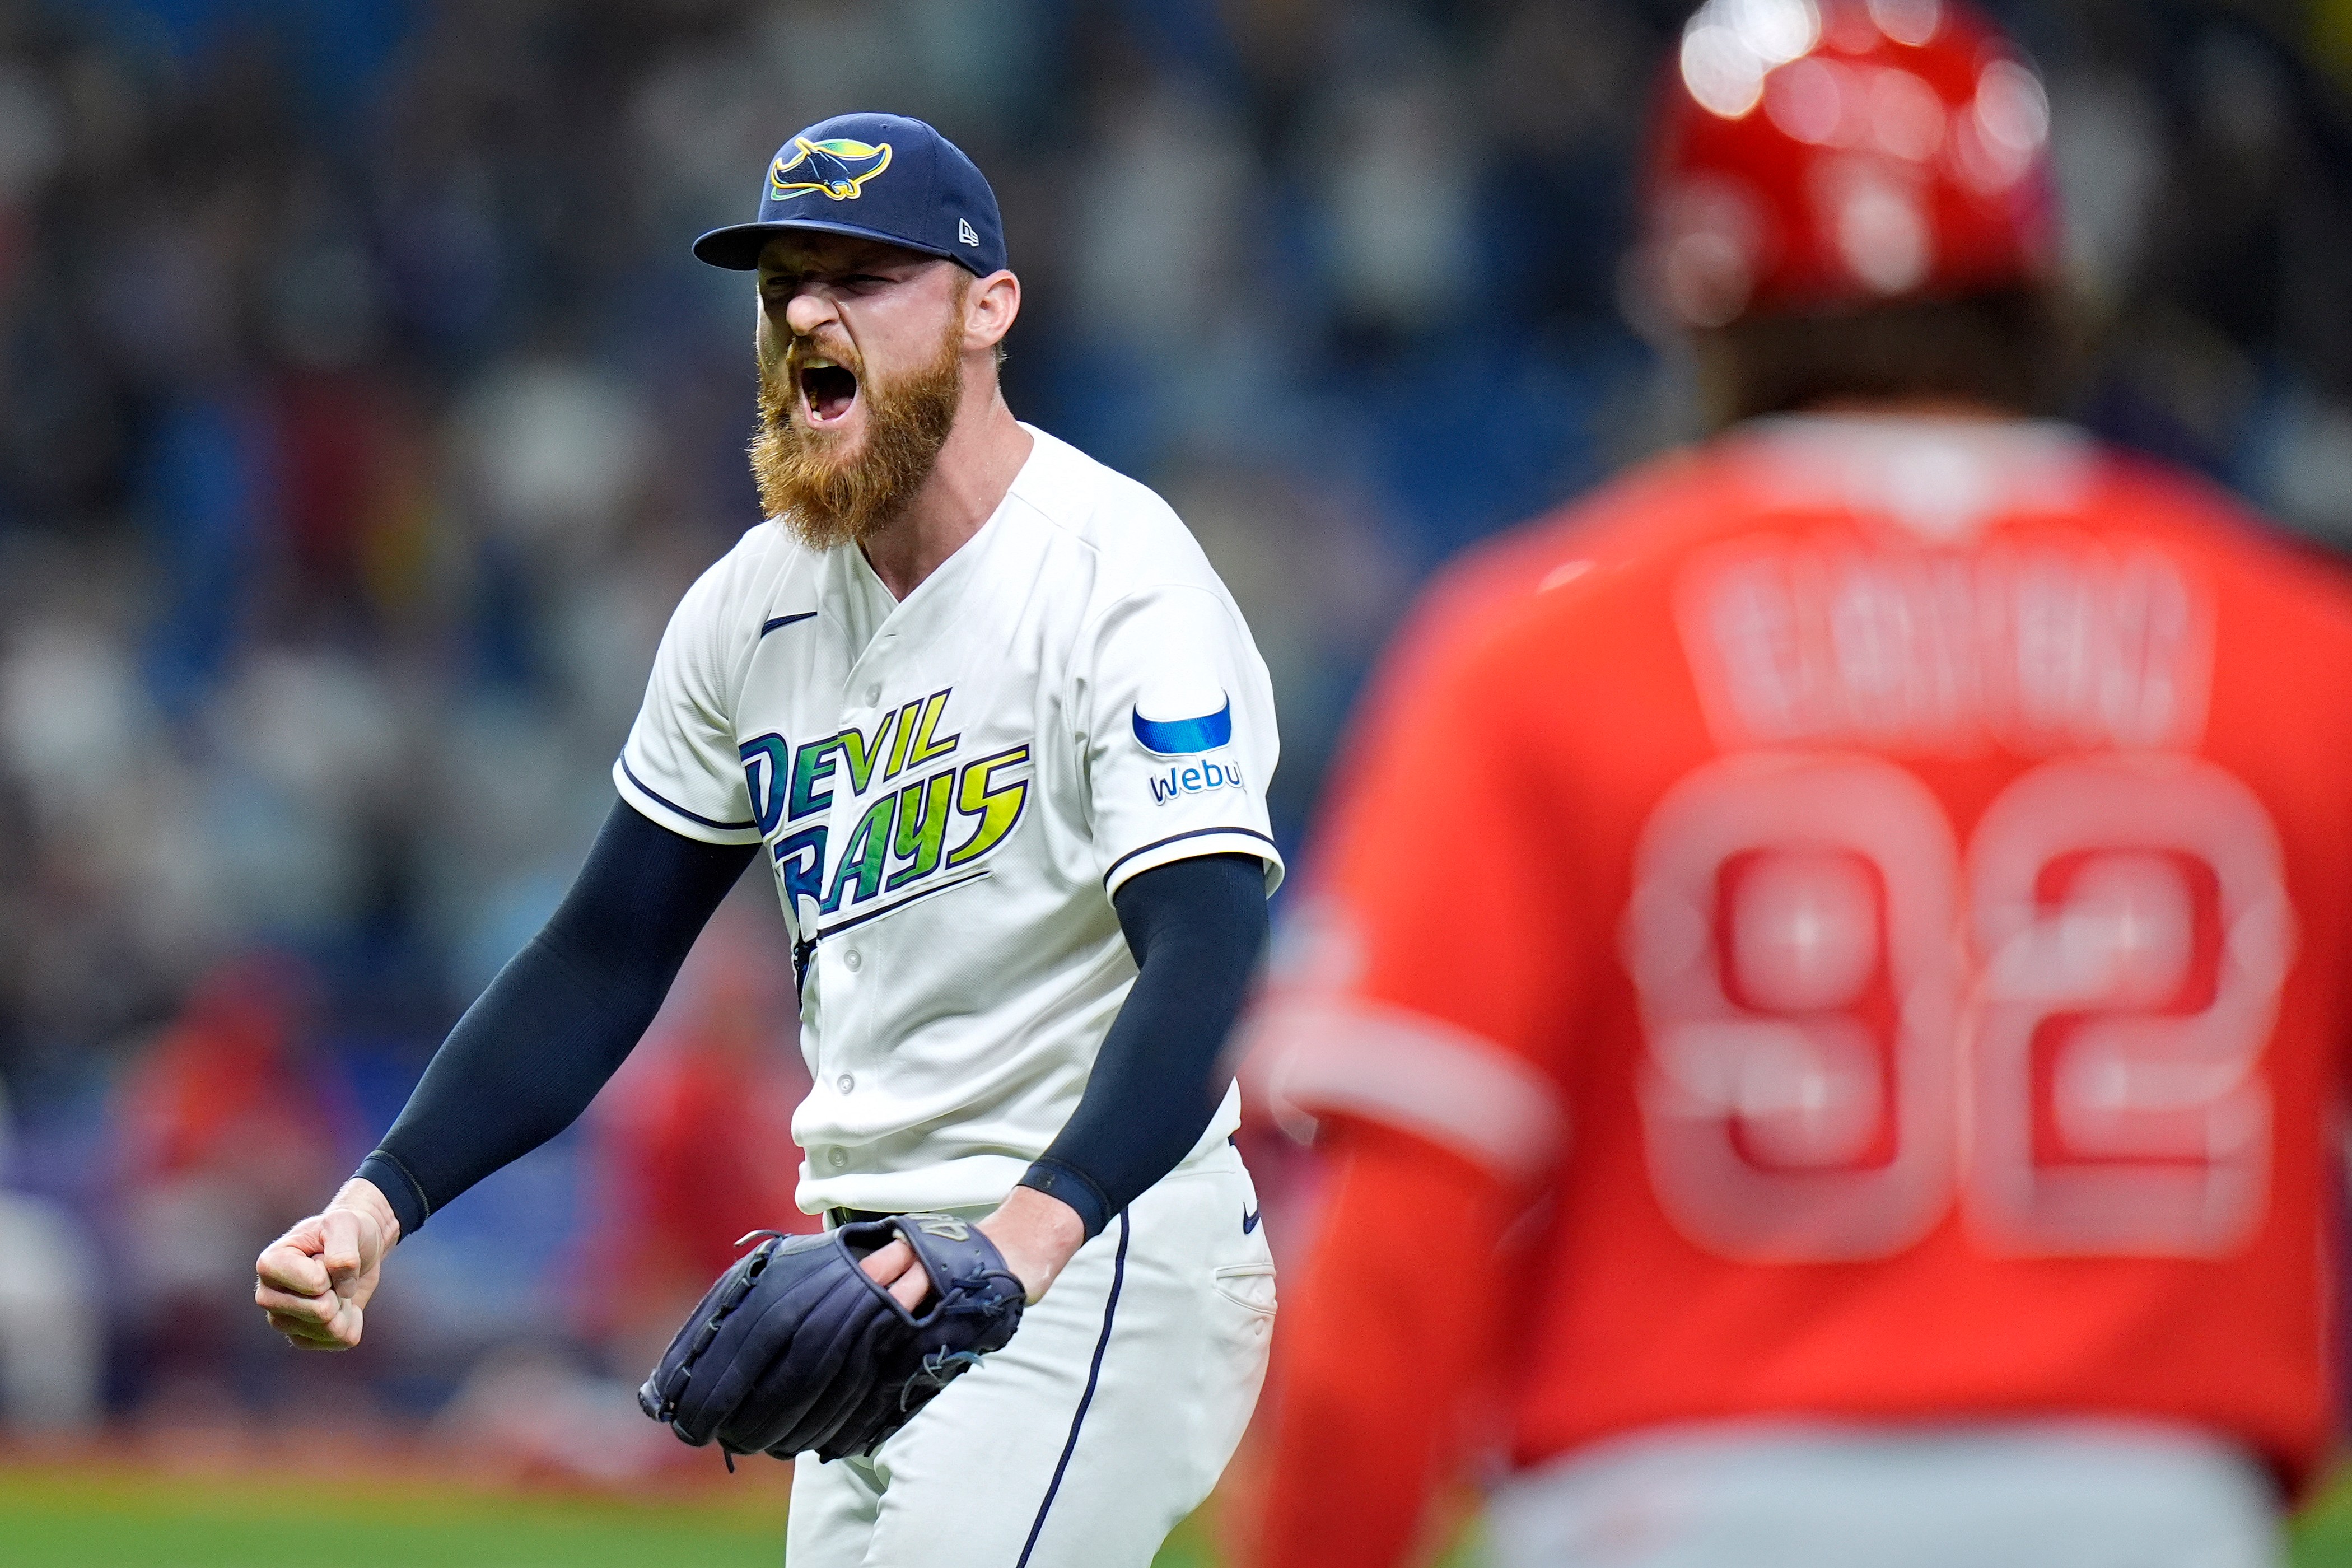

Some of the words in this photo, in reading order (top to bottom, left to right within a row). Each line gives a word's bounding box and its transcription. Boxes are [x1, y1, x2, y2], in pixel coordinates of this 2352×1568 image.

[739, 687, 962, 838] DEVIL
[774, 743, 1030, 924] RAYS
[1628, 752, 2293, 1263] 92
